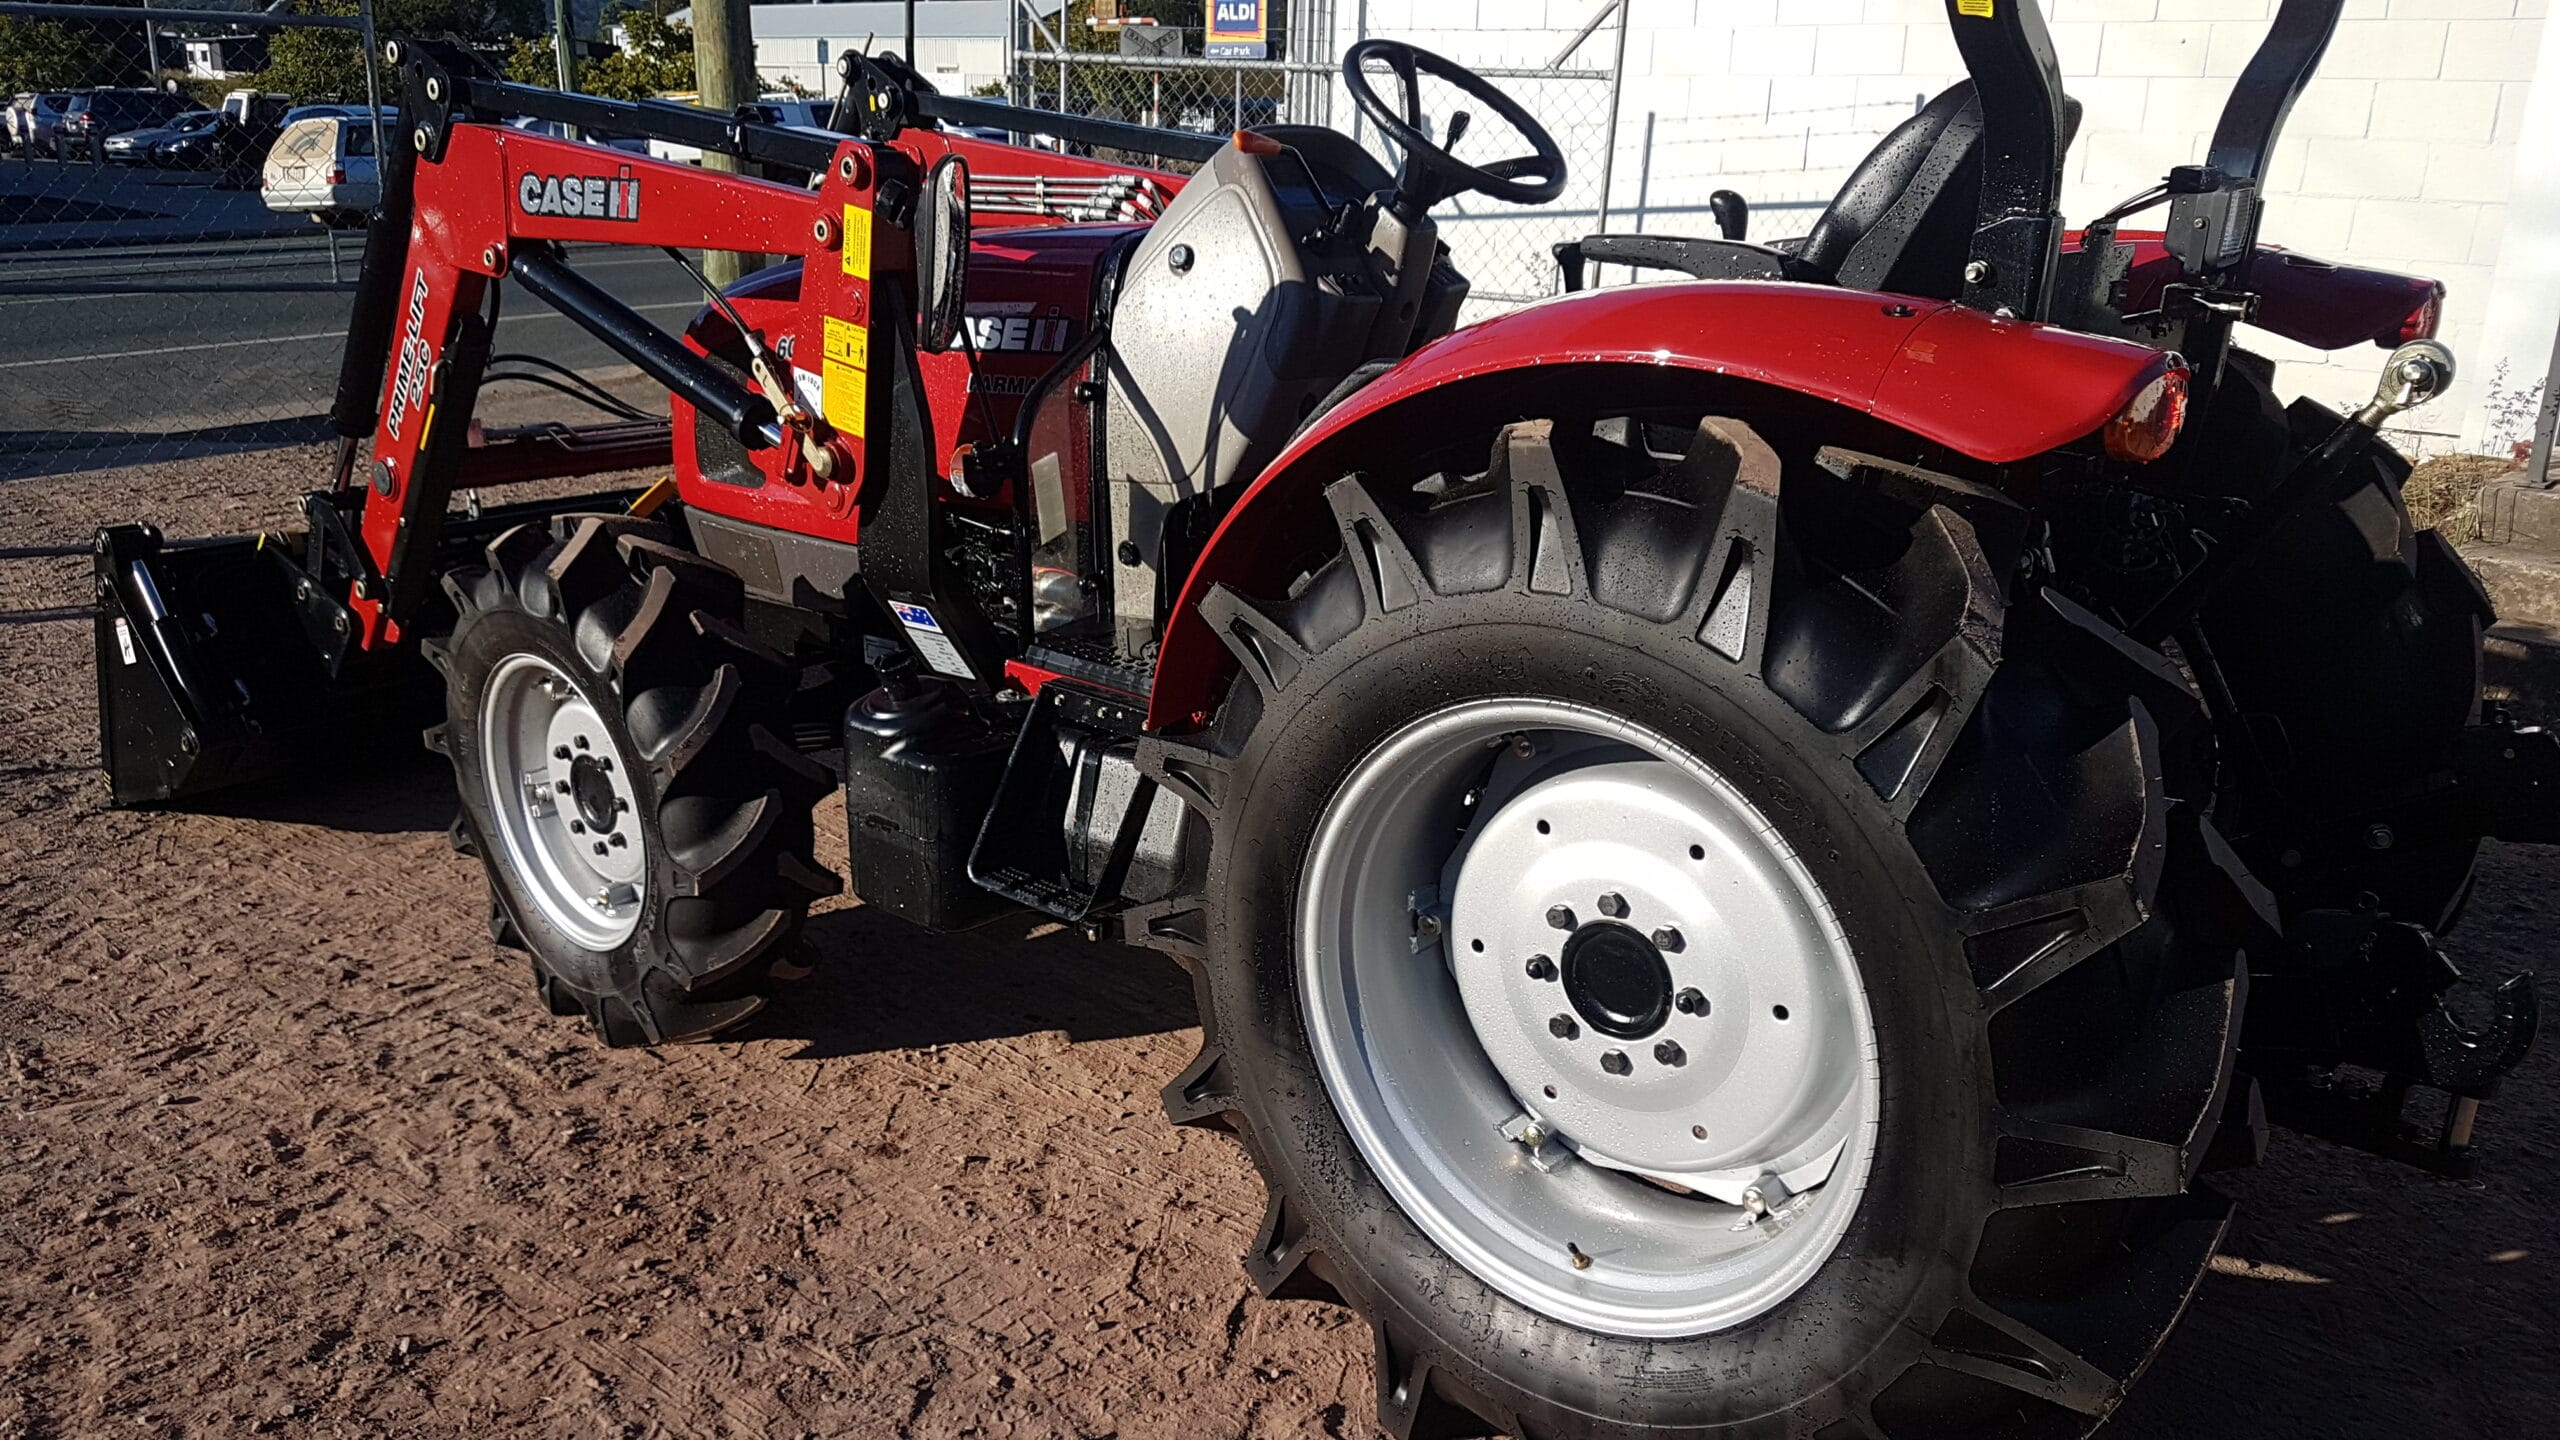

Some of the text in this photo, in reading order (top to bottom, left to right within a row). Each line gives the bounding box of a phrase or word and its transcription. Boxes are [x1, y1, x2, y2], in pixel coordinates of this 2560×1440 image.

[1217, 3, 1256, 21] ALDI
[1220, 46, 1251, 56] Car Park
[519, 173, 606, 217] CASE
[949, 316, 1030, 351] ASE
[387, 266, 429, 442] PRIME-LIFT
